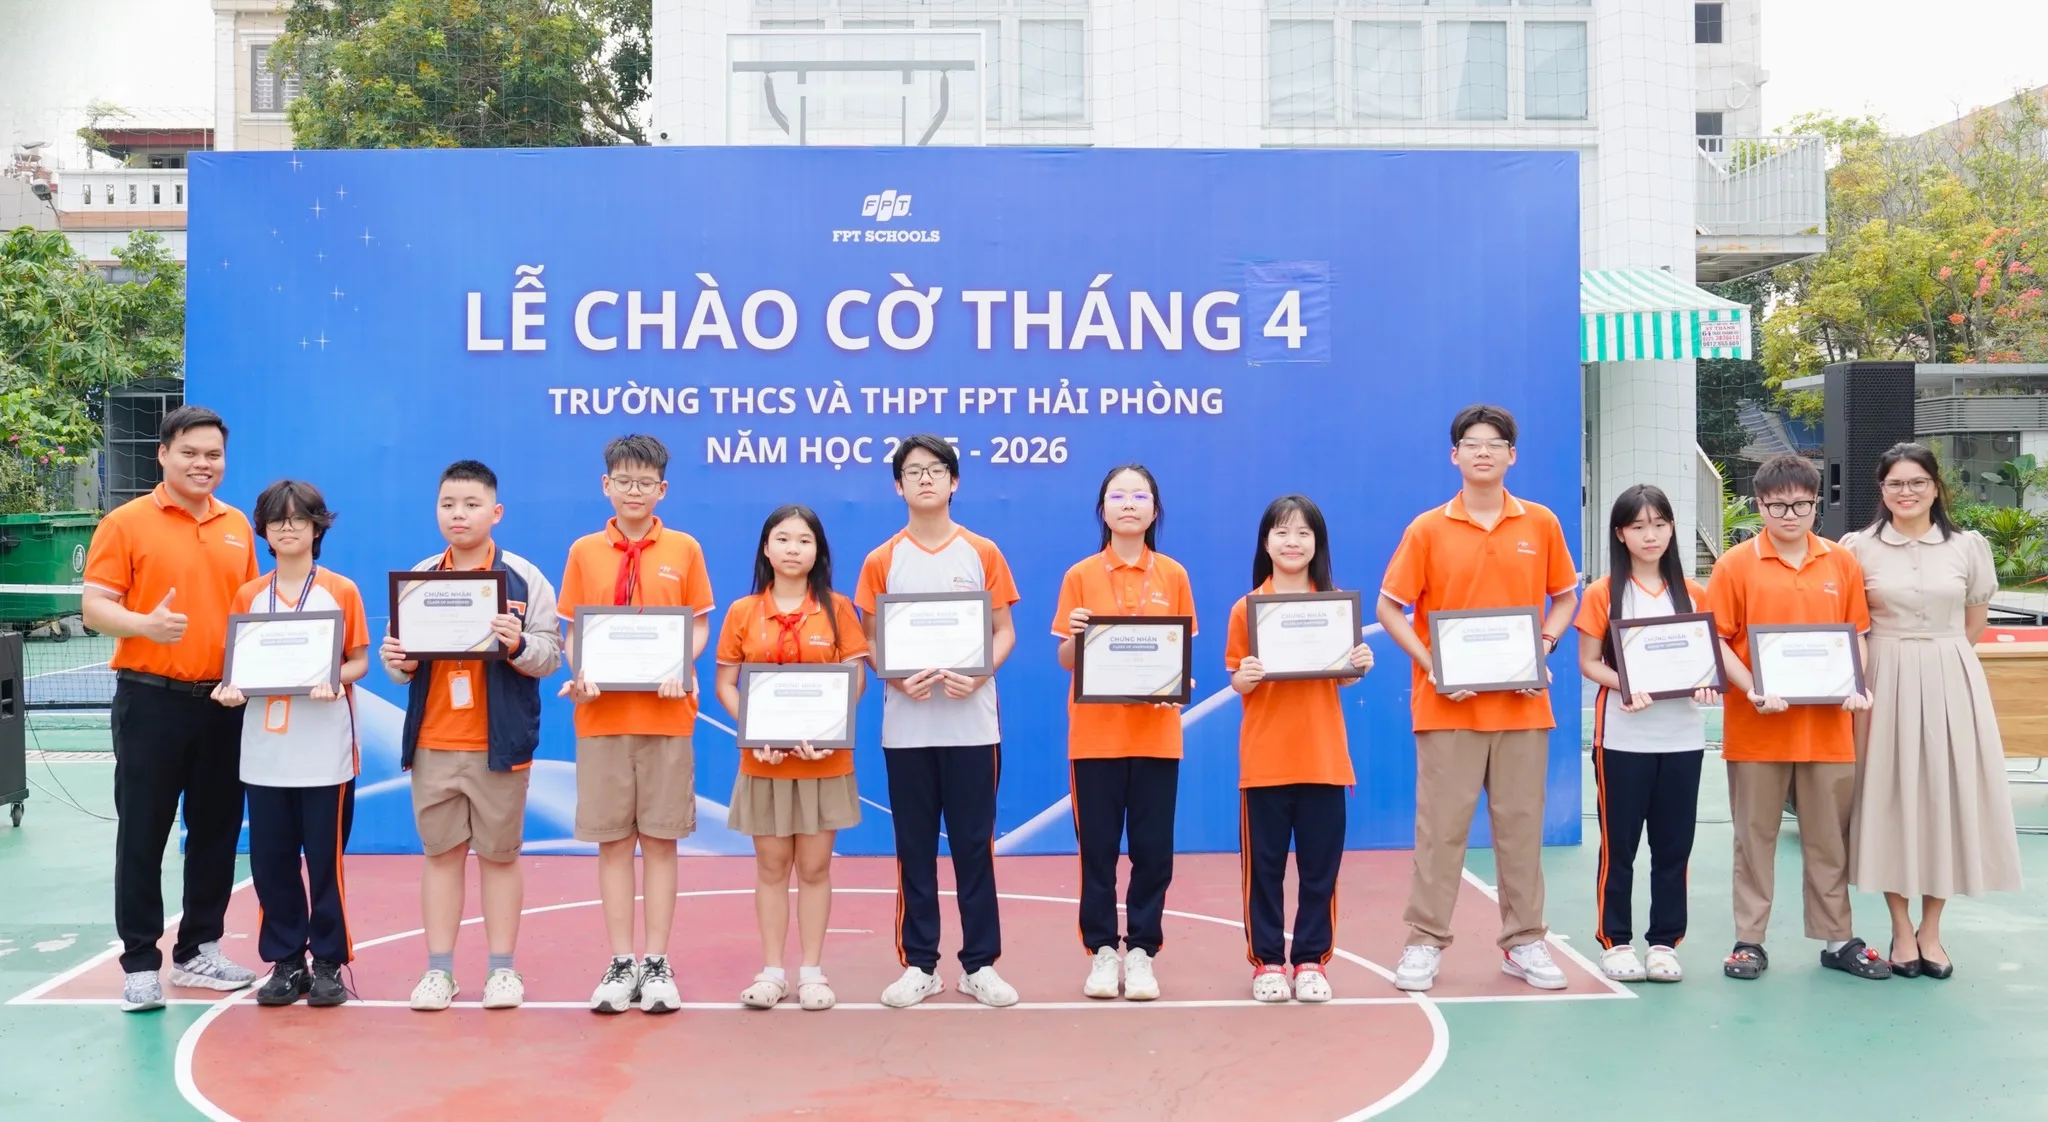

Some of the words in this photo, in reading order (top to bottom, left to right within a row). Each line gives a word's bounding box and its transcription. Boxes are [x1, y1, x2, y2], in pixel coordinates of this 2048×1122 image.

[832, 230, 861, 242] FPT
[865, 230, 940, 243] SCHOOLS
[467, 265, 546, 351] LỄ
[575, 272, 798, 351] CHÀO
[827, 272, 943, 351] CỜ
[963, 273, 1241, 351] THÁNG
[1263, 290, 1307, 349] 4
[549, 381, 699, 415] TRƯỜNG
[709, 387, 796, 414] THCS
[806, 380, 852, 414] VÀ
[860, 387, 948, 414] THPT
[959, 387, 1018, 414] FPT
[1029, 379, 1089, 414] HẢI
[1100, 381, 1223, 415] PHÒNG
[707, 430, 787, 463] NĂM
[800, 436, 873, 470] HỌC
[884, 437, 960, 463] 25
[991, 437, 1068, 464] 2026
